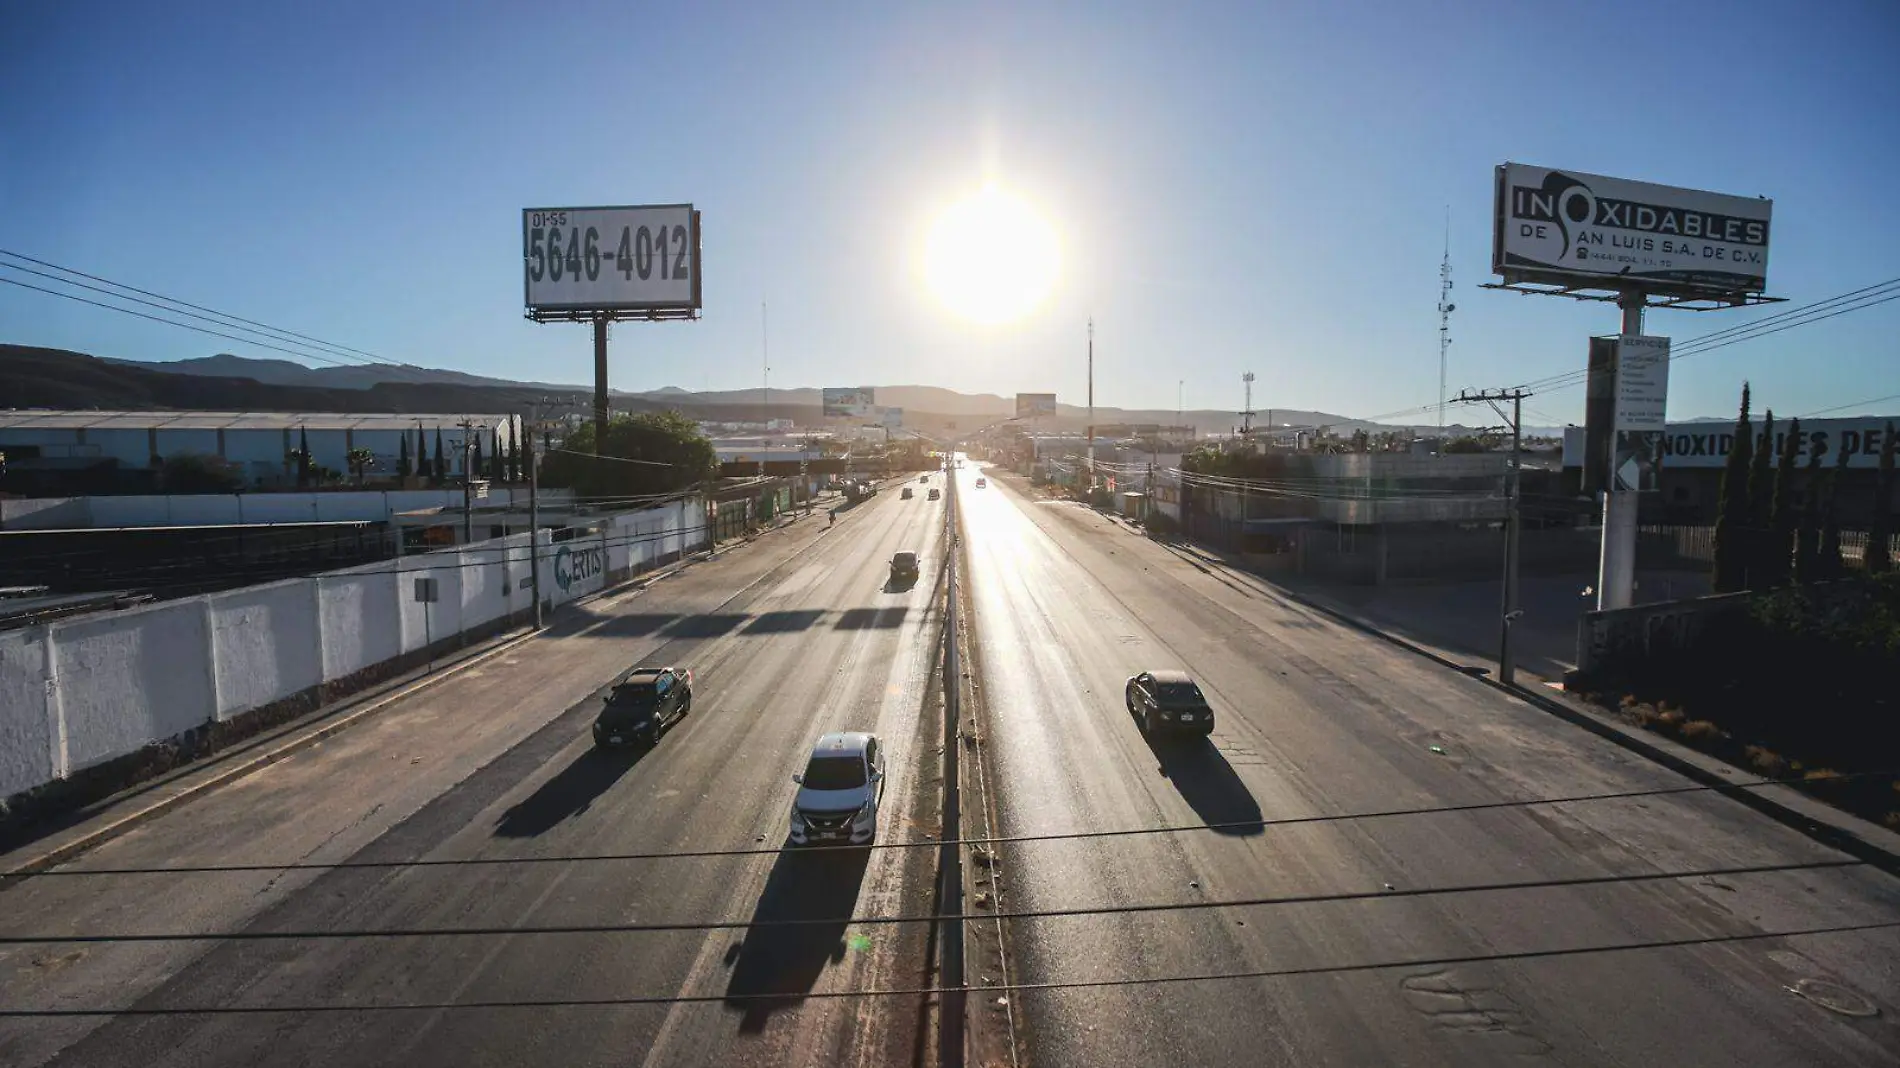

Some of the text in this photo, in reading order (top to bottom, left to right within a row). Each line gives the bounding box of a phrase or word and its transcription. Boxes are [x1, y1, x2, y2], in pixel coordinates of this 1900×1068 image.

[1517, 185, 1765, 242] INOXIDABLES
[530, 225, 688, 282] 5646-4012
[1520, 223, 1547, 239] DE
[1612, 234, 1653, 251] LUIS
[1662, 240, 1695, 257] S.A.
[1703, 246, 1725, 260] DE
[1732, 250, 1761, 264] C.V.
[1841, 429, 1882, 455] DE
